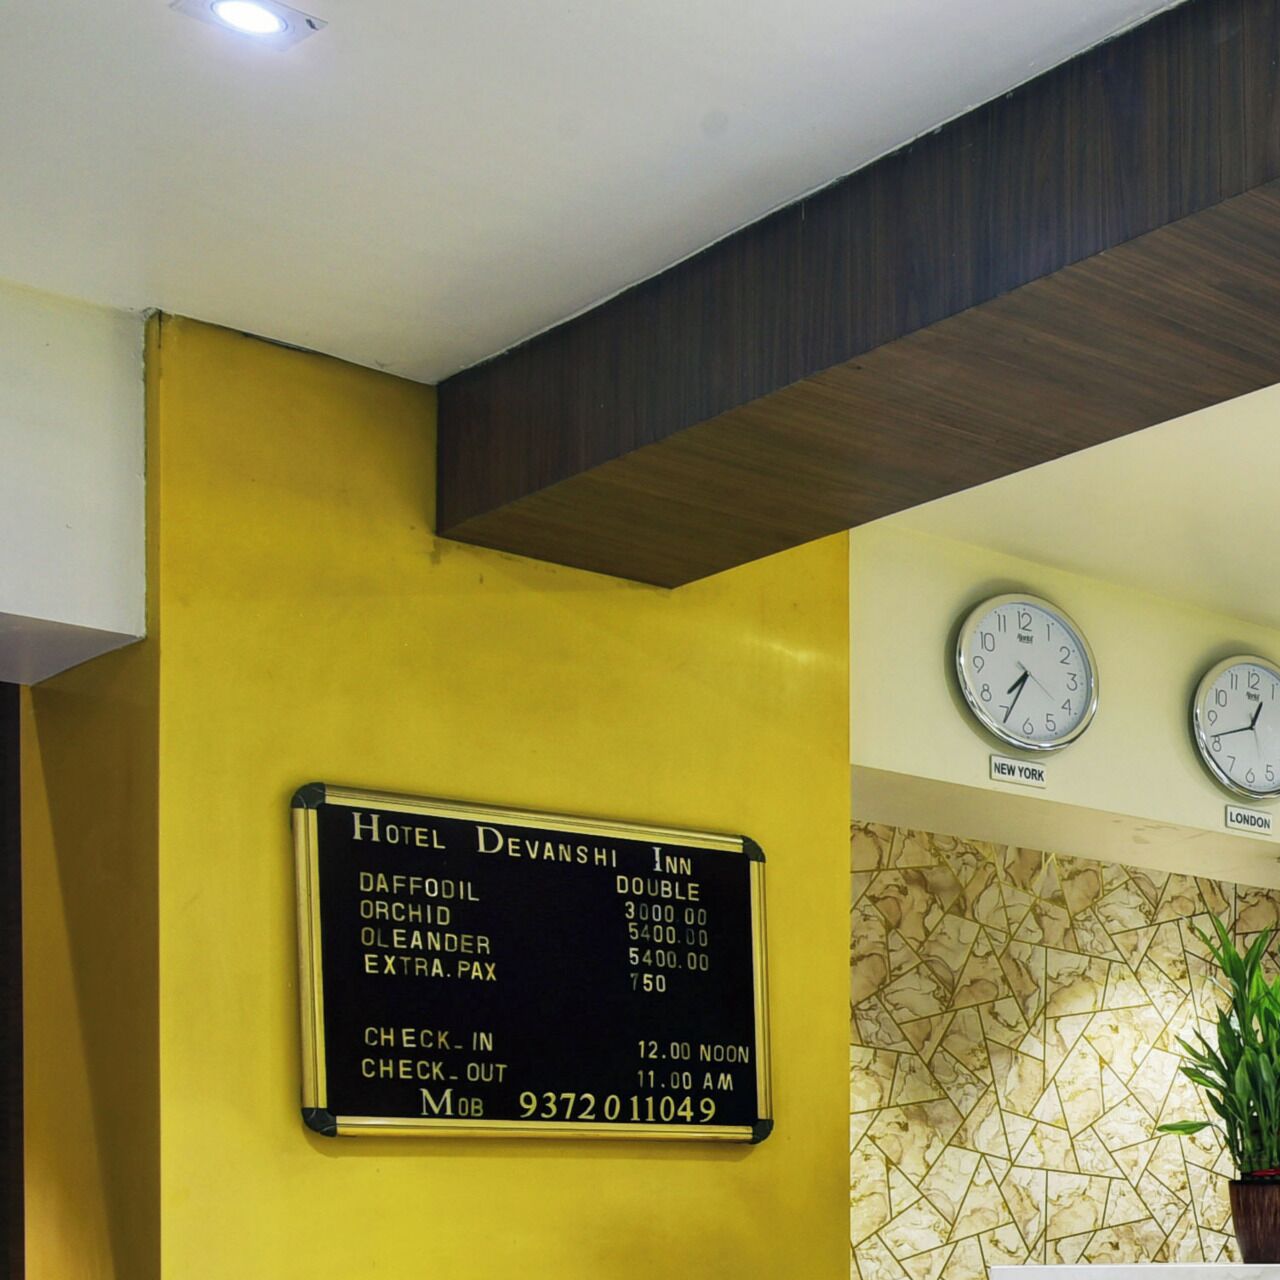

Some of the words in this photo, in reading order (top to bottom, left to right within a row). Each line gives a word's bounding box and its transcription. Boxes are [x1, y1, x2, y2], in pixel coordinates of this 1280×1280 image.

[997, 614, 1006, 632] 11
[1017, 611, 1032, 632] 12
[980, 632, 995, 651] 10
[973, 656, 984, 673] 9
[1059, 646, 1070, 664] 2
[1067, 672, 1078, 691] 3
[1230, 673, 1238, 690] 11
[1248, 671, 1260, 690] 12
[980, 683, 992, 701] 8
[1215, 688, 1227, 707] 10
[1062, 699, 1071, 716] 4
[1023, 718, 1034, 735] 6
[1045, 714, 1056, 732] 5
[1208, 710, 1217, 726] 9
[994, 763, 1016, 777] NEW
[1018, 766, 1044, 782] YORK
[1227, 755, 1236, 773] 7
[1265, 765, 1275, 782] 5
[1245, 768, 1255, 783] 6
[1230, 811, 1270, 829] LONDON
[352, 812, 446, 849] HOTEL
[476, 826, 617, 867] DEVANSHI
[652, 847, 692, 875] INN
[360, 872, 480, 901] DAFFODIL
[616, 875, 700, 901] DOUBLE
[360, 900, 450, 925] ORCHID
[628, 922, 708, 946] 5400.00
[361, 927, 490, 955] OLEANDER
[629, 947, 709, 971] 5400.00
[630, 973, 666, 992] 750
[639, 1040, 691, 1060] 12.00
[699, 1044, 749, 1063] NOON
[638, 1070, 692, 1090] 11.00
[703, 1072, 734, 1091] AM
[419, 1088, 484, 1117] MOB
